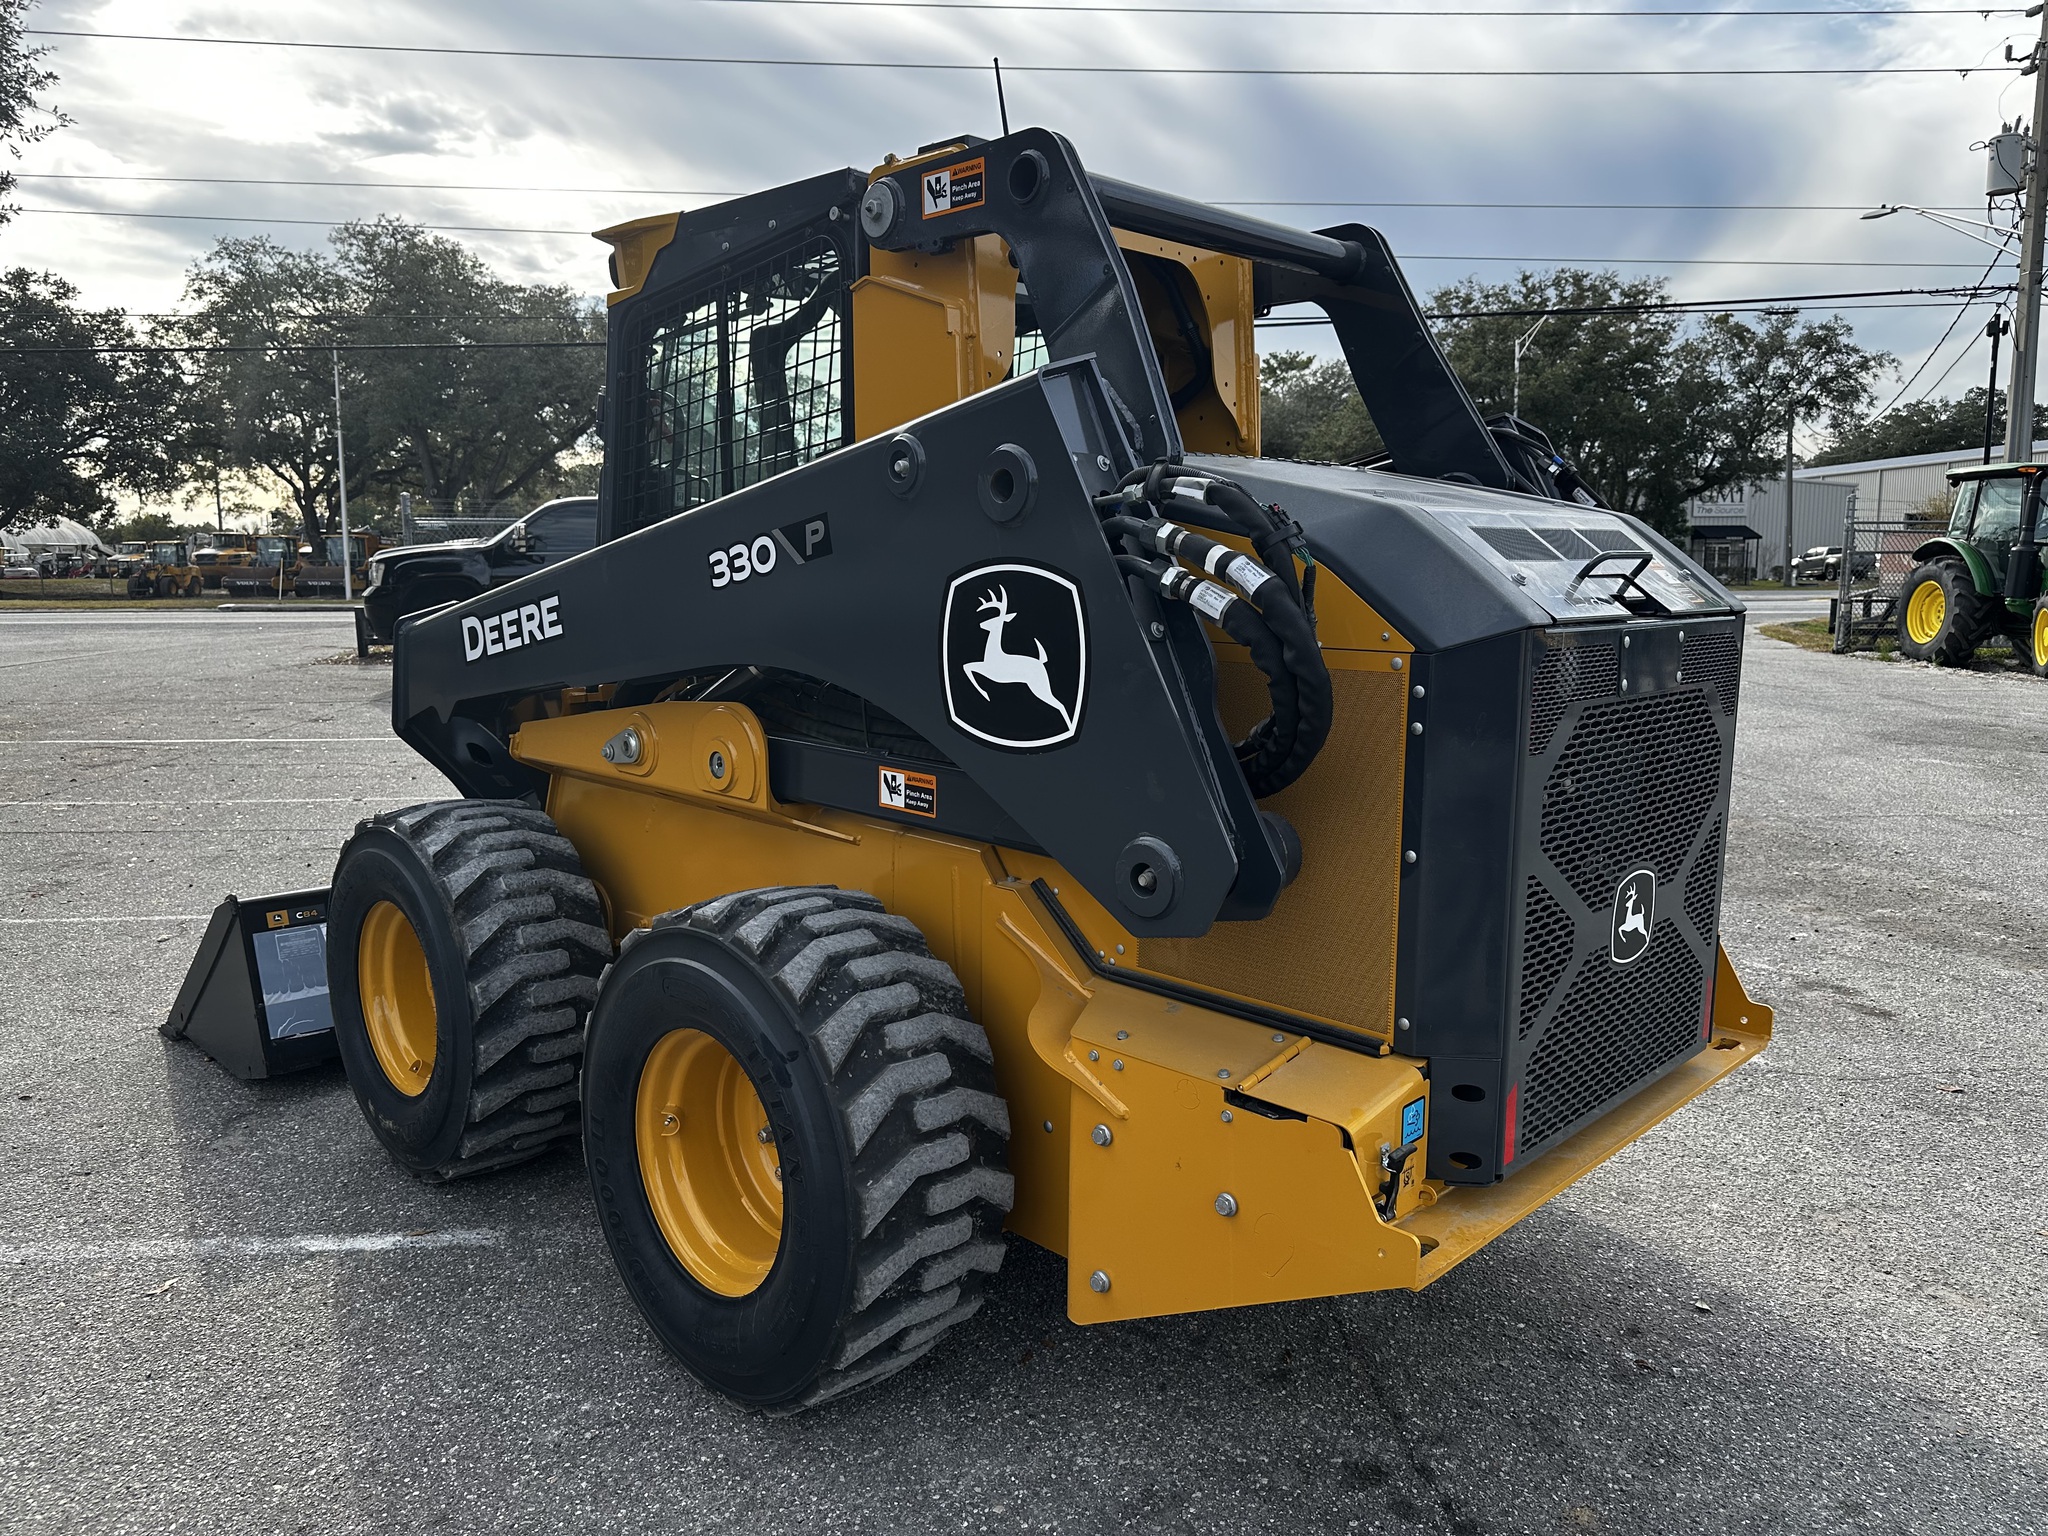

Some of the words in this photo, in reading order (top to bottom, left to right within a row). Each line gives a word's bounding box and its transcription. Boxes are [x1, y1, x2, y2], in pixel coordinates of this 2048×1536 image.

[956, 162, 982, 176] WARNING
[951, 183, 968, 193] Pinch
[968, 180, 981, 189] Area
[951, 194, 964, 202] Keep
[964, 191, 977, 199] Away
[1697, 506, 1713, 514] The
[1714, 506, 1744, 514] Source
[708, 535, 777, 588] 330
[805, 520, 825, 556] P
[461, 595, 563, 662] DEERE
[910, 775, 934, 786] WARNING
[906, 789, 921, 799] Pinch
[920, 792, 933, 801] Area
[906, 798, 917, 806] Keep
[917, 801, 929, 809] Away
[295, 909, 318, 919] C84
